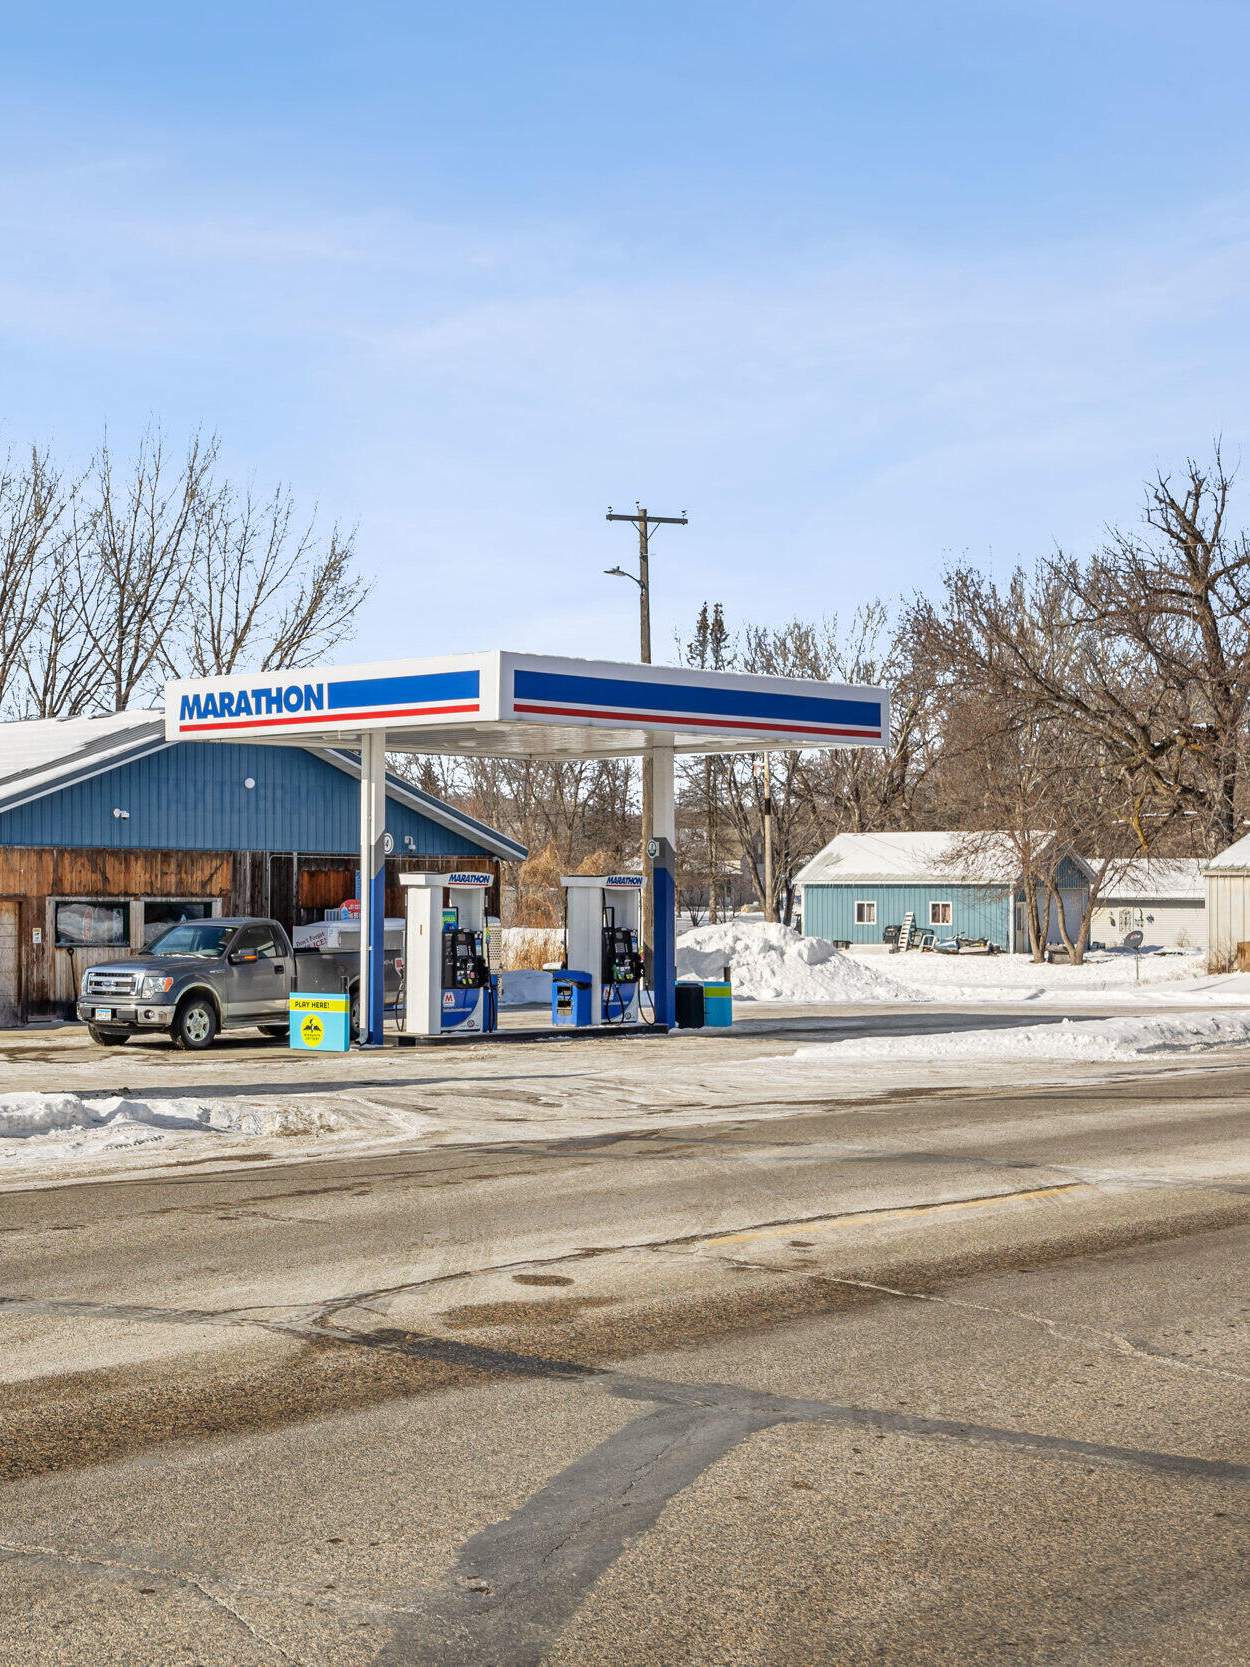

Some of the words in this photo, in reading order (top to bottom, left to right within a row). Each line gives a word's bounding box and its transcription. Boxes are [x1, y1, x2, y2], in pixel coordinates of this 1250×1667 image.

[179, 683, 324, 721] MARATHON
[449, 873, 490, 884] MARATHON
[606, 876, 643, 885] MARATHON
